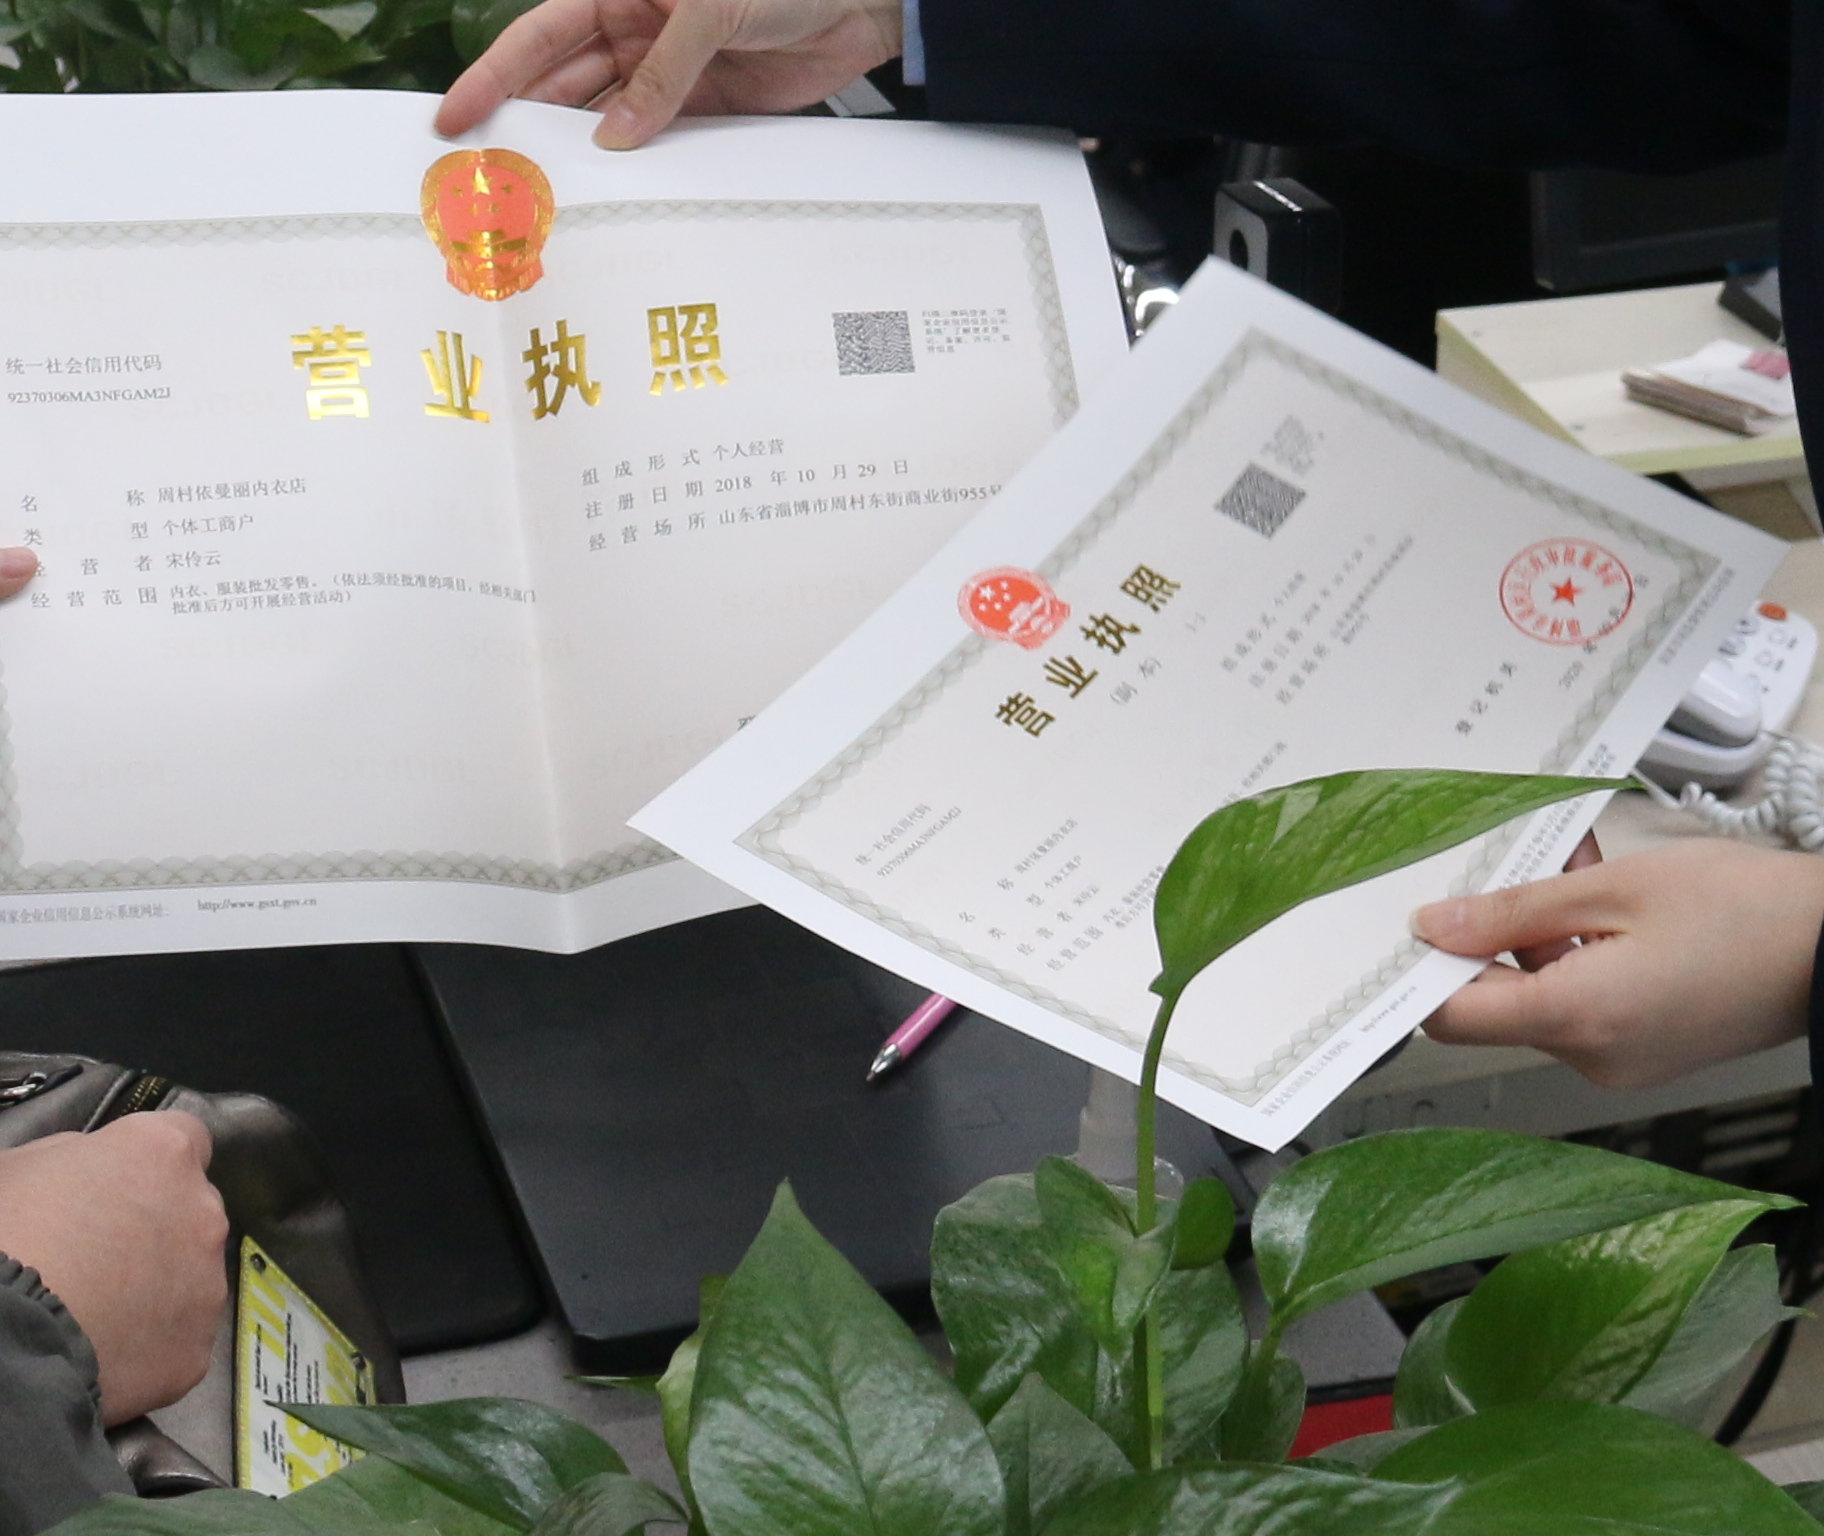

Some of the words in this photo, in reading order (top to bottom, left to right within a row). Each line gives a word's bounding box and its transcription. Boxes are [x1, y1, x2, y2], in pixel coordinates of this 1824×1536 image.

[5, 354, 162, 375] 统一社会信用代码
[290, 302, 729, 424] 营业执照
[8, 386, 171, 405] 92370306MA3NFGAM2J
[713, 438, 785, 462] 个人经营
[157, 477, 306, 504] 周村依曼丽内衣店
[163, 513, 255, 537] 个体工商户
[166, 549, 223, 569] 宋伶云
[31, 586, 158, 609] 经营范围
[995, 563, 1181, 738] 营业执照
